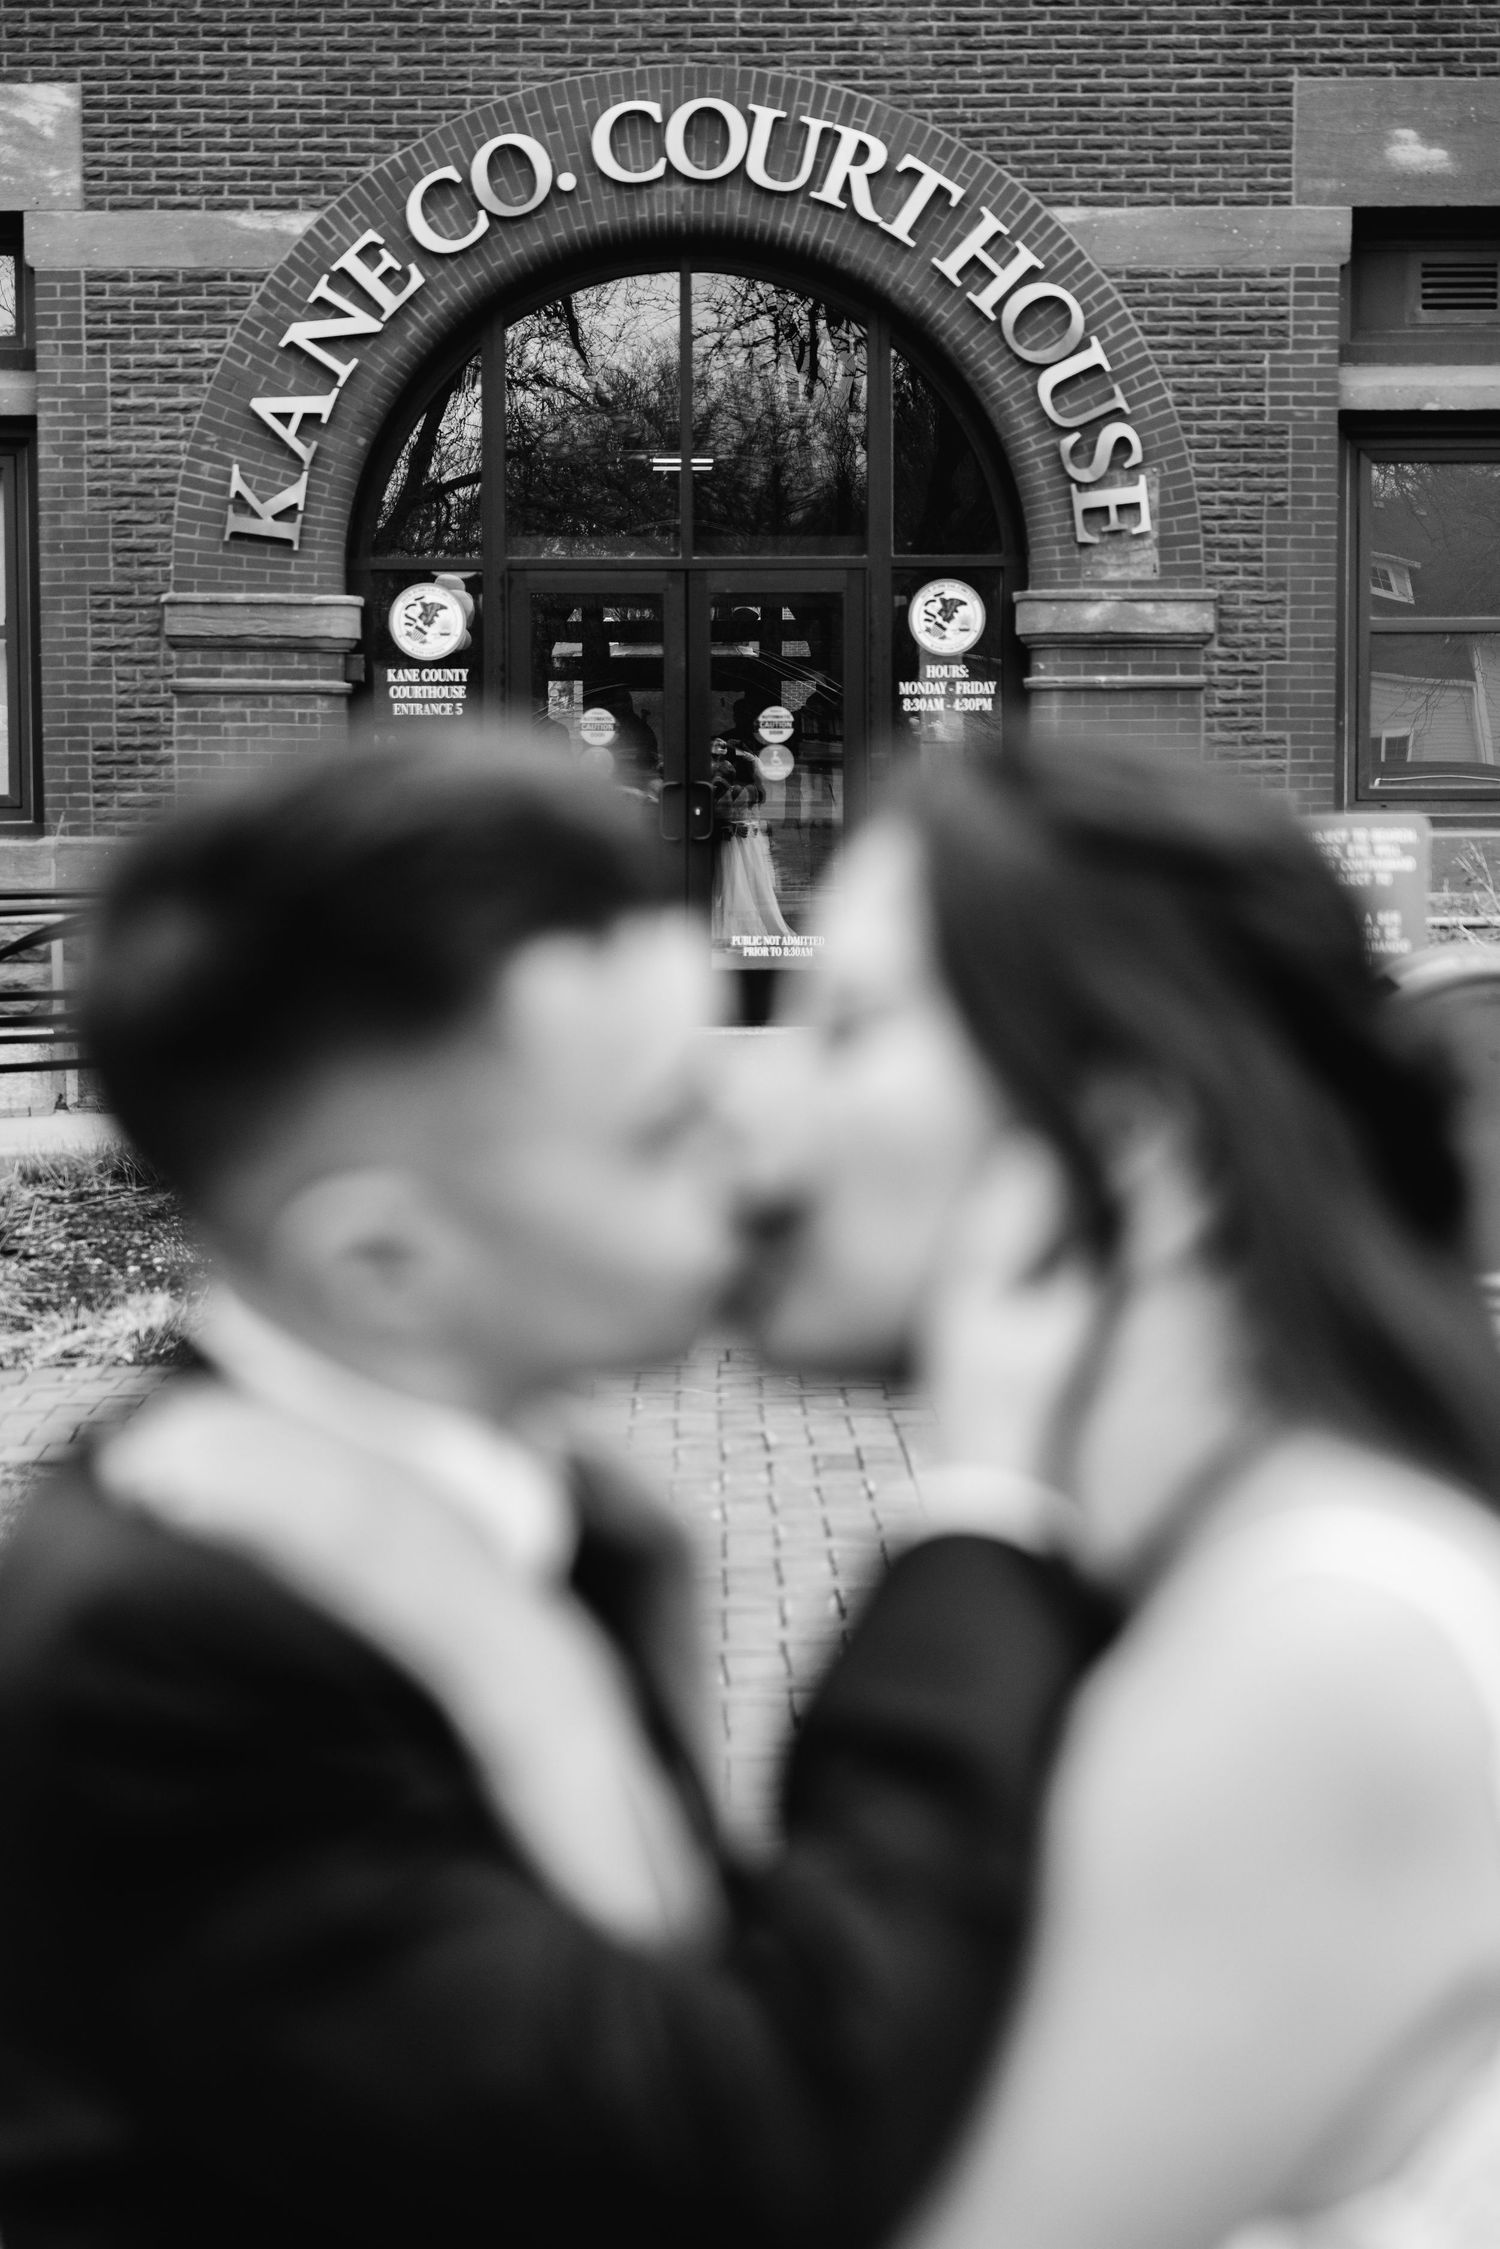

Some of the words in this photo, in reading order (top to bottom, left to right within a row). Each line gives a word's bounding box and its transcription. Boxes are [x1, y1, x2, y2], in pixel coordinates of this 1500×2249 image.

[224, 228, 426, 550] KANE
[406, 133, 577, 254] CO.
[591, 97, 966, 247] COURT
[931, 206, 1152, 545] HOUSE
[386, 668, 420, 682] KANE
[420, 668, 469, 682] COUNTY
[926, 664, 969, 678] HOURS:
[389, 685, 466, 699] COURTHOUSE
[899, 681, 947, 695] MONDAY
[955, 681, 997, 695] FRIDAY
[392, 702, 454, 716] ENTRANCE
[455, 702, 463, 716] 5
[902, 698, 944, 711] 8:30AM
[952, 698, 993, 711] 4:30PM
[731, 935, 762, 946] PUBLIC
[763, 935, 781, 946] NOT
[781, 935, 825, 946] ADMITTED
[743, 946, 769, 957] PRIOR
[769, 946, 782, 957] TO
[783, 946, 814, 957] 8:30AM
